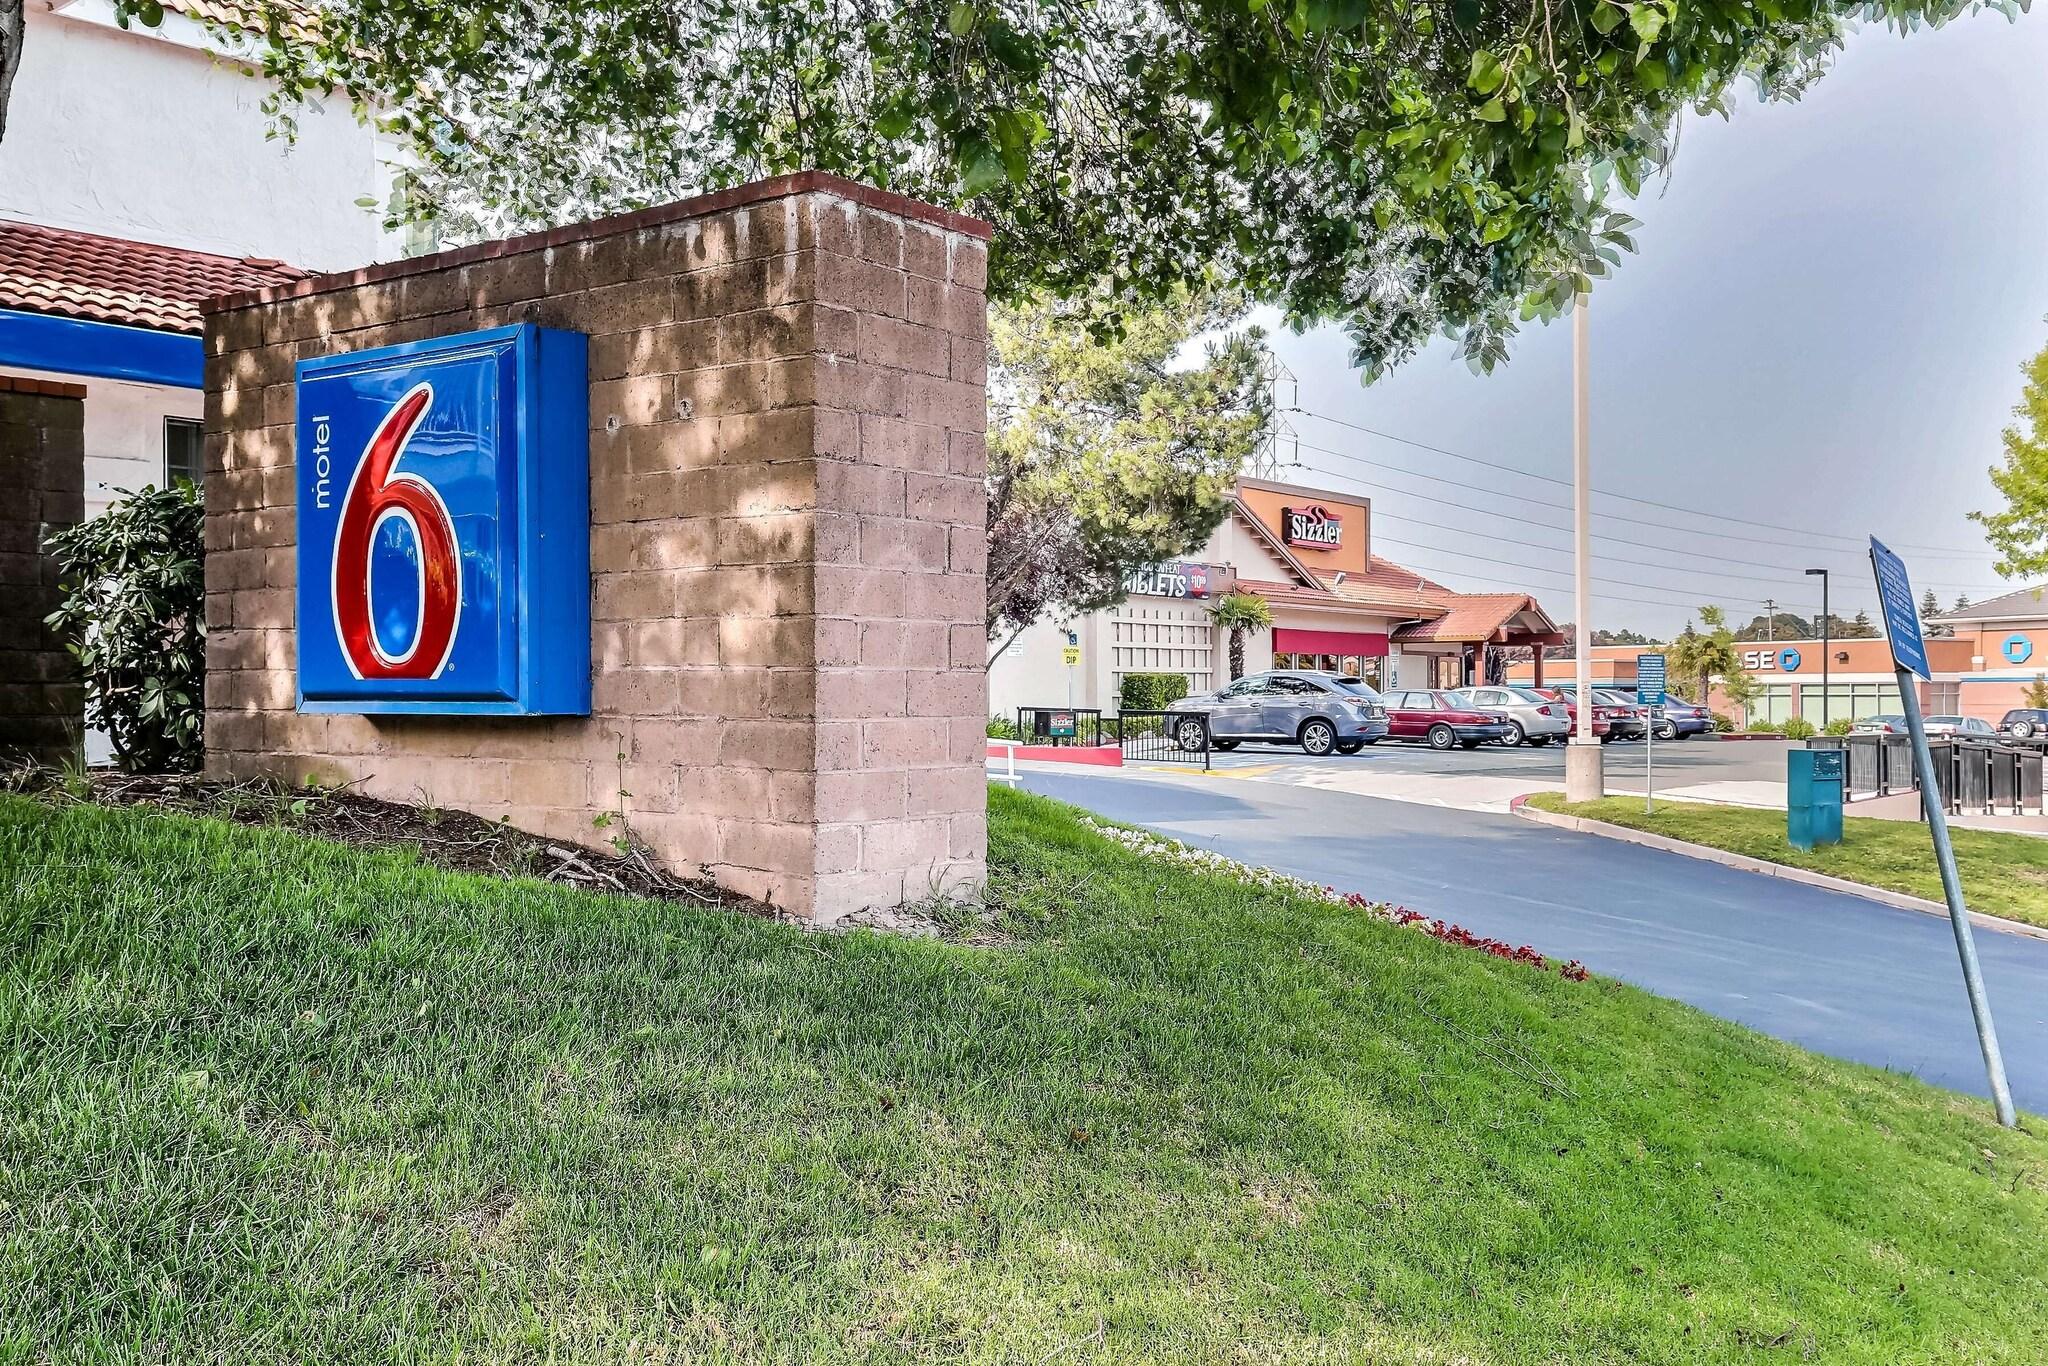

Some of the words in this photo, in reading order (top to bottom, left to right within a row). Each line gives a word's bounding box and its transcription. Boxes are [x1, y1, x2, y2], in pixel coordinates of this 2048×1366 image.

[312, 415, 330, 508] motel
[331, 382, 463, 680] 6
[1292, 512, 1343, 544] Sizzler
[1066, 656, 1077, 664] DIP
